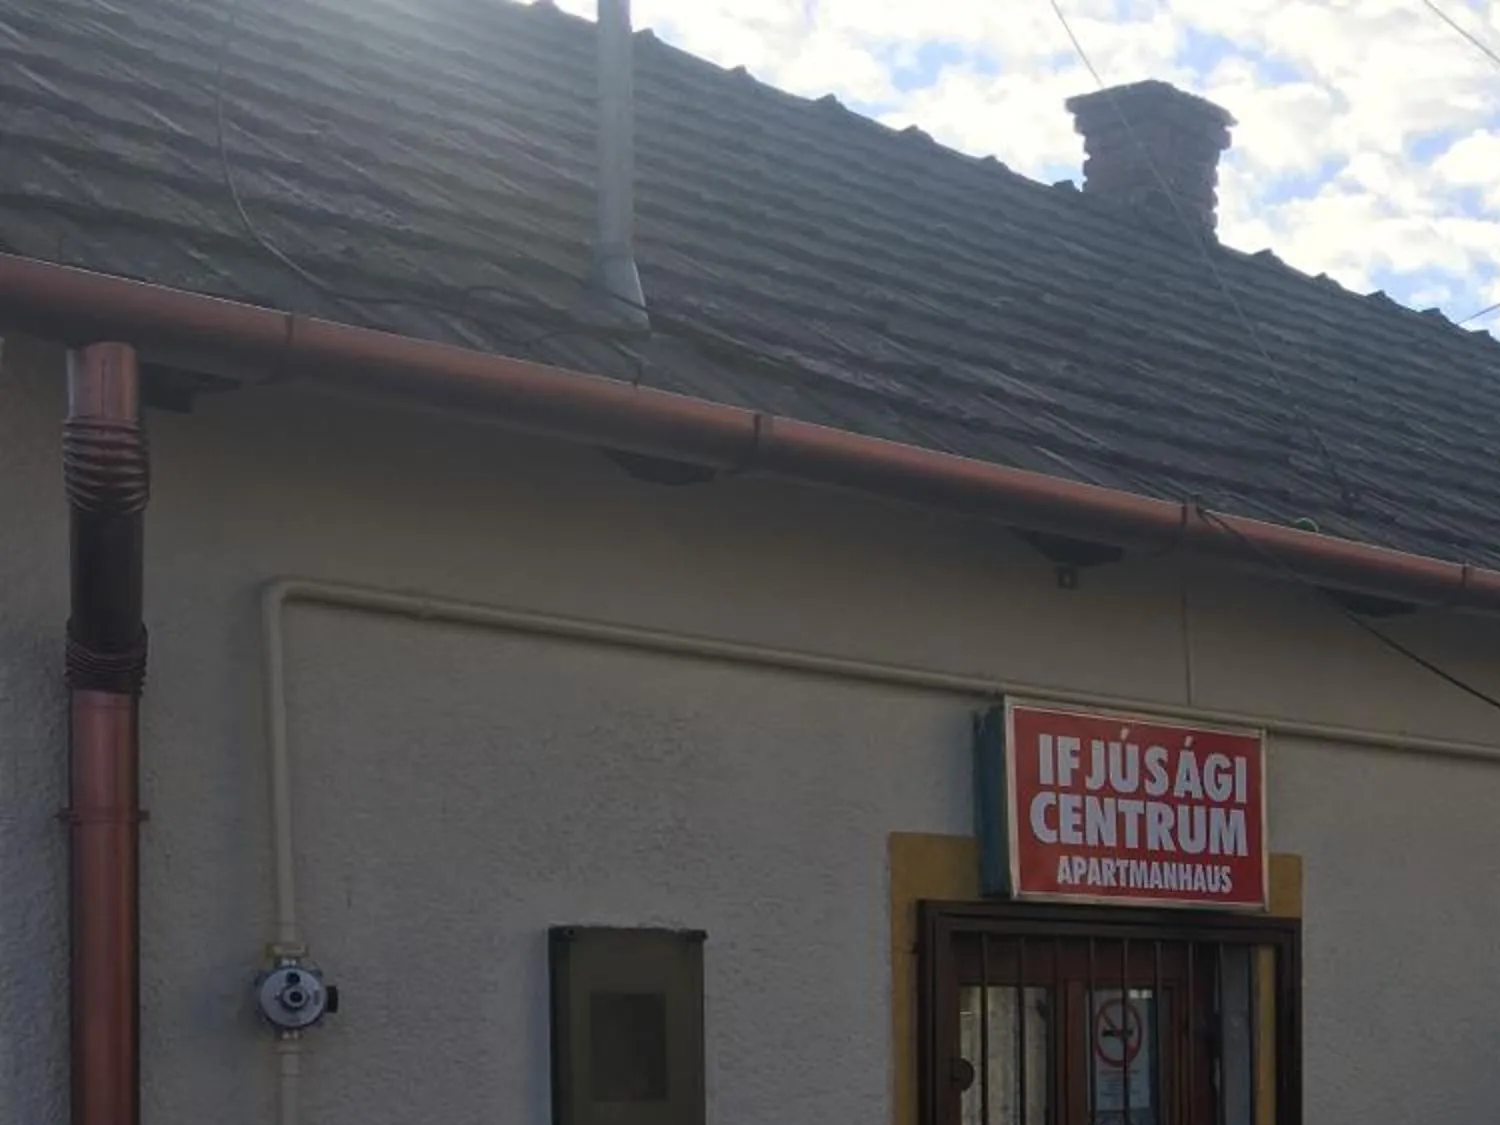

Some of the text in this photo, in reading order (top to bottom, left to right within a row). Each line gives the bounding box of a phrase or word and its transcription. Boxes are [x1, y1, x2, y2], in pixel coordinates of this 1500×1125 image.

[1038, 728, 1248, 804] IFJÚSÁGI
[1029, 792, 1249, 857] CENTRUM
[1056, 856, 1233, 894] APARTMANHAUS
